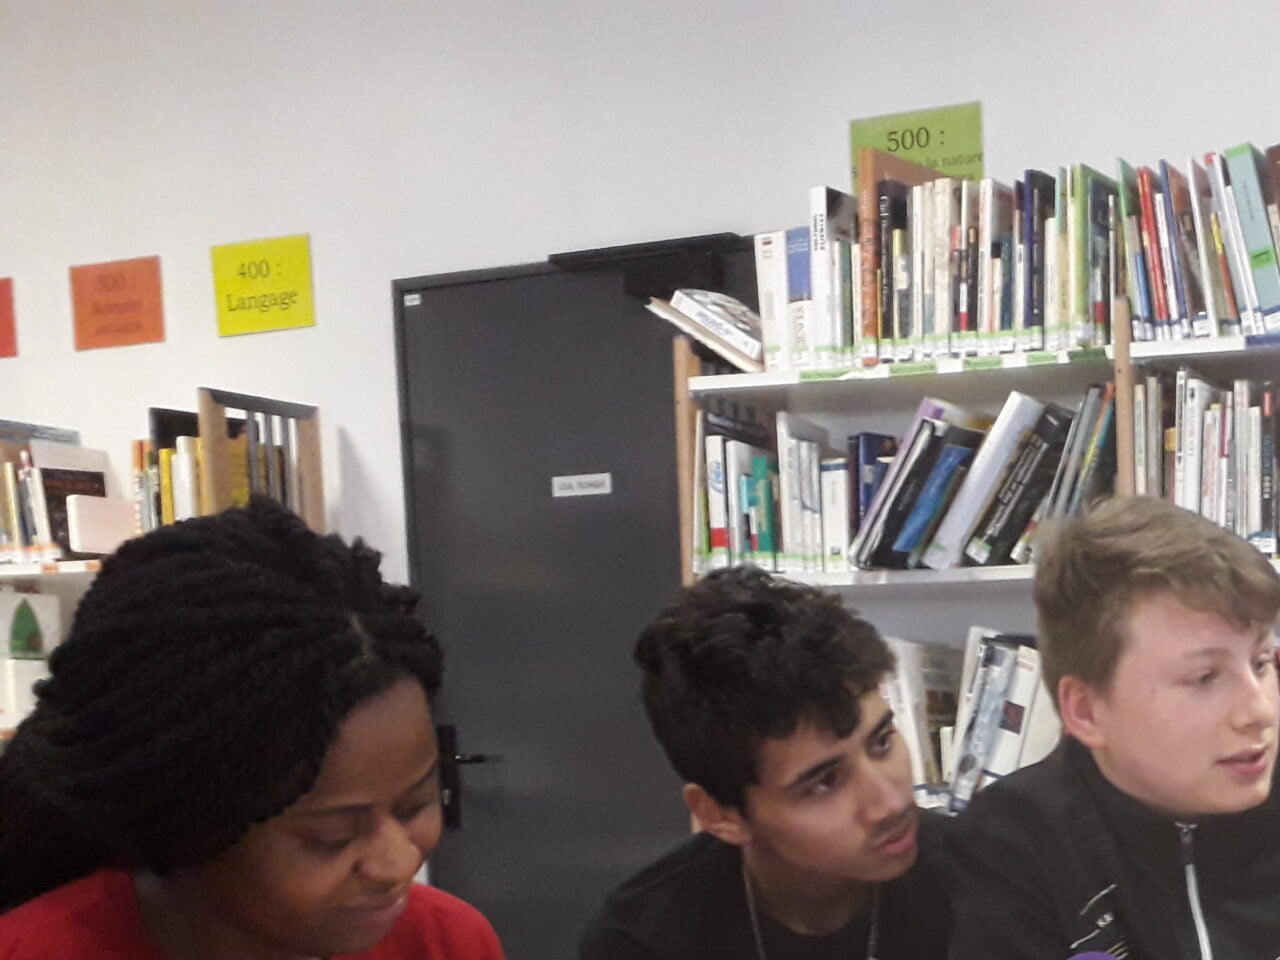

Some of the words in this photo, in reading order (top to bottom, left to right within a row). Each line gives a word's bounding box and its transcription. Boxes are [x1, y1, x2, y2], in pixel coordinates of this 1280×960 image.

[886, 126, 930, 152] 500
[236, 260, 269, 279] 400
[225, 288, 299, 313] Langage
